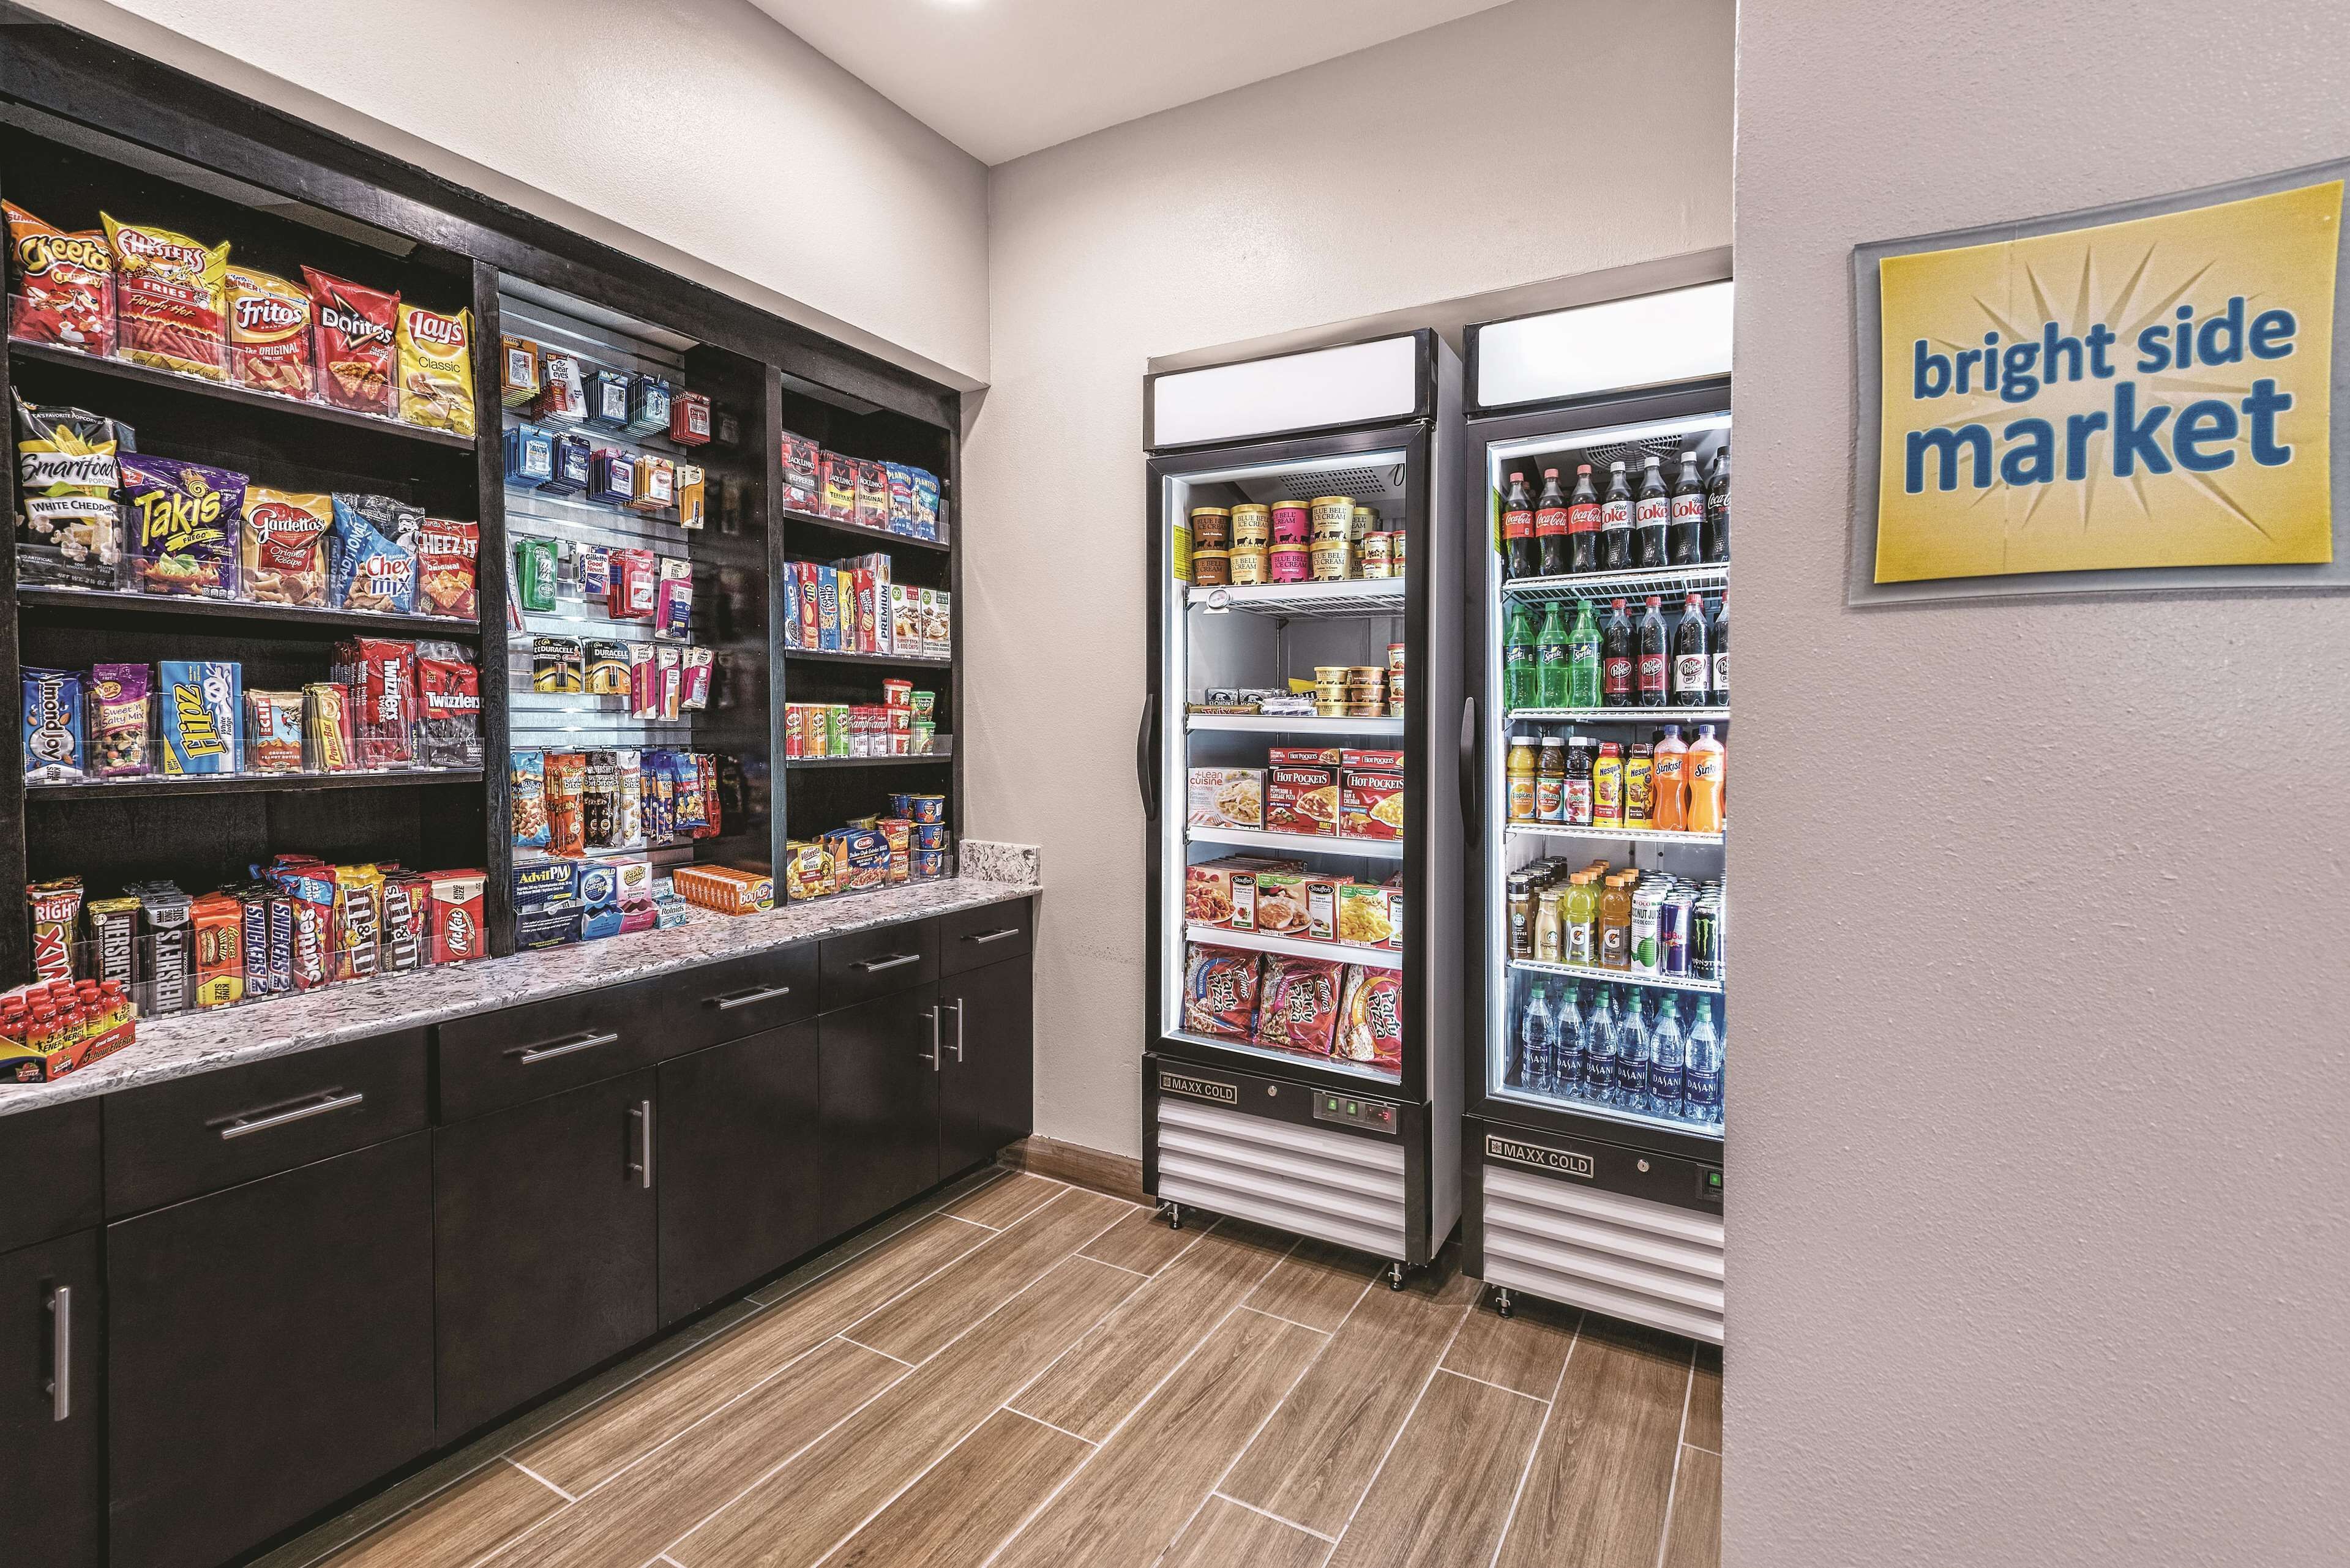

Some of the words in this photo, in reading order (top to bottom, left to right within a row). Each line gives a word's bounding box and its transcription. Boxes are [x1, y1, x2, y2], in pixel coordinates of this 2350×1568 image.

[117, 228, 206, 274] CHESTER'S
[143, 281, 187, 299] FRIES
[171, 305, 195, 316] Hot
[236, 296, 302, 329] Fritos
[323, 307, 393, 343] Doritos
[414, 312, 463, 344] Lay's
[1914, 321, 2116, 403] bright
[2137, 296, 2296, 373] side
[419, 356, 461, 373] Classic
[551, 364, 569, 373] Clear
[1906, 378, 2293, 493] market
[21, 454, 116, 483] Smartfood
[788, 474, 815, 487] PEPPERED
[888, 471, 911, 486] PLANTERS
[915, 477, 937, 493] PLANTERS
[134, 489, 220, 547] Takis
[1571, 507, 1601, 525] Coca-Cola
[1637, 504, 1667, 521] Coke
[1673, 501, 1704, 518] Coke
[249, 508, 326, 544] Gardetto's
[1505, 512, 1530, 526] Coca-Cola
[1536, 511, 1566, 528] Coca-Cola
[183, 532, 207, 545] FUEGO
[270, 546, 307, 559] Original
[273, 555, 303, 568] Recipe
[367, 553, 412, 578] Chex
[805, 582, 815, 602] RITZ
[825, 584, 835, 608] Chips
[1506, 650, 1524, 663] Sprite
[1544, 650, 1561, 662] Sprite
[1574, 649, 1593, 661] Sprite
[1611, 665, 1631, 678] Pepper
[1642, 663, 1663, 676] Pepper
[1682, 663, 1705, 676] Pepper
[384, 658, 400, 721] Twizzlers
[425, 691, 481, 709] Twizzlers
[102, 707, 132, 719] Sweet
[102, 717, 126, 728] Salty
[127, 711, 144, 720] Mix
[259, 700, 271, 728] CLIF
[174, 684, 228, 760] Flipz
[41, 730, 65, 761] Joy
[323, 722, 340, 762] PowerBar
[1600, 764, 1621, 776] Nesquik
[1631, 766, 1652, 777] Nesquik
[1656, 760, 1683, 775] Sunkist
[1276, 772, 1292, 782] HOT
[1293, 772, 1328, 783] POCKETS
[1351, 776, 1366, 786] HOT
[1368, 777, 1404, 790] POCKETS
[801, 847, 820, 861] Velveeta
[519, 870, 550, 884] Advil
[550, 864, 568, 880] PM
[588, 876, 602, 885] Alka-
[623, 867, 646, 878] Pepto-
[626, 873, 646, 883] Bismol
[1233, 876, 1254, 885] Stouffer's
[585, 880, 605, 892] Seltzer
[1309, 885, 1332, 894] Stouffer's
[739, 886, 769, 906] bounce
[164, 909, 173, 922] KING
[173, 908, 184, 921] SIZE
[661, 905, 684, 916] Rolaids
[227, 925, 240, 960] Reese's
[246, 906, 267, 976] SNICKERS
[271, 903, 291, 975] SNICKERS
[1570, 925, 1585, 946] G
[1604, 928, 1620, 949] G
[156, 930, 182, 1010] HERSHEY'S
[258, 977, 267, 993] 2
[1198, 965, 1210, 995] COMBINATION
[1235, 968, 1250, 999] Totino's
[1207, 971, 1223, 1014] Pizza
[1221, 969, 1238, 1011] Party
[1315, 978, 1331, 1014] Totino's
[1289, 982, 1302, 1023] Pizza
[1301, 979, 1317, 1023] Party
[1368, 991, 1385, 1039] Pizza
[1382, 988, 1402, 1037] Party
[1522, 1051, 1548, 1065] DASANI
[1587, 1062, 1614, 1075] DASANI
[1618, 1066, 1645, 1080] DASANI
[1172, 1078, 1202, 1095] MAXX
[1205, 1085, 1233, 1100] COLD
[1653, 1075, 1681, 1087] DASANI
[1688, 1079, 1716, 1093] DASANI
[1503, 1143, 1545, 1164] MAXX
[1549, 1154, 1588, 1173] COLD
